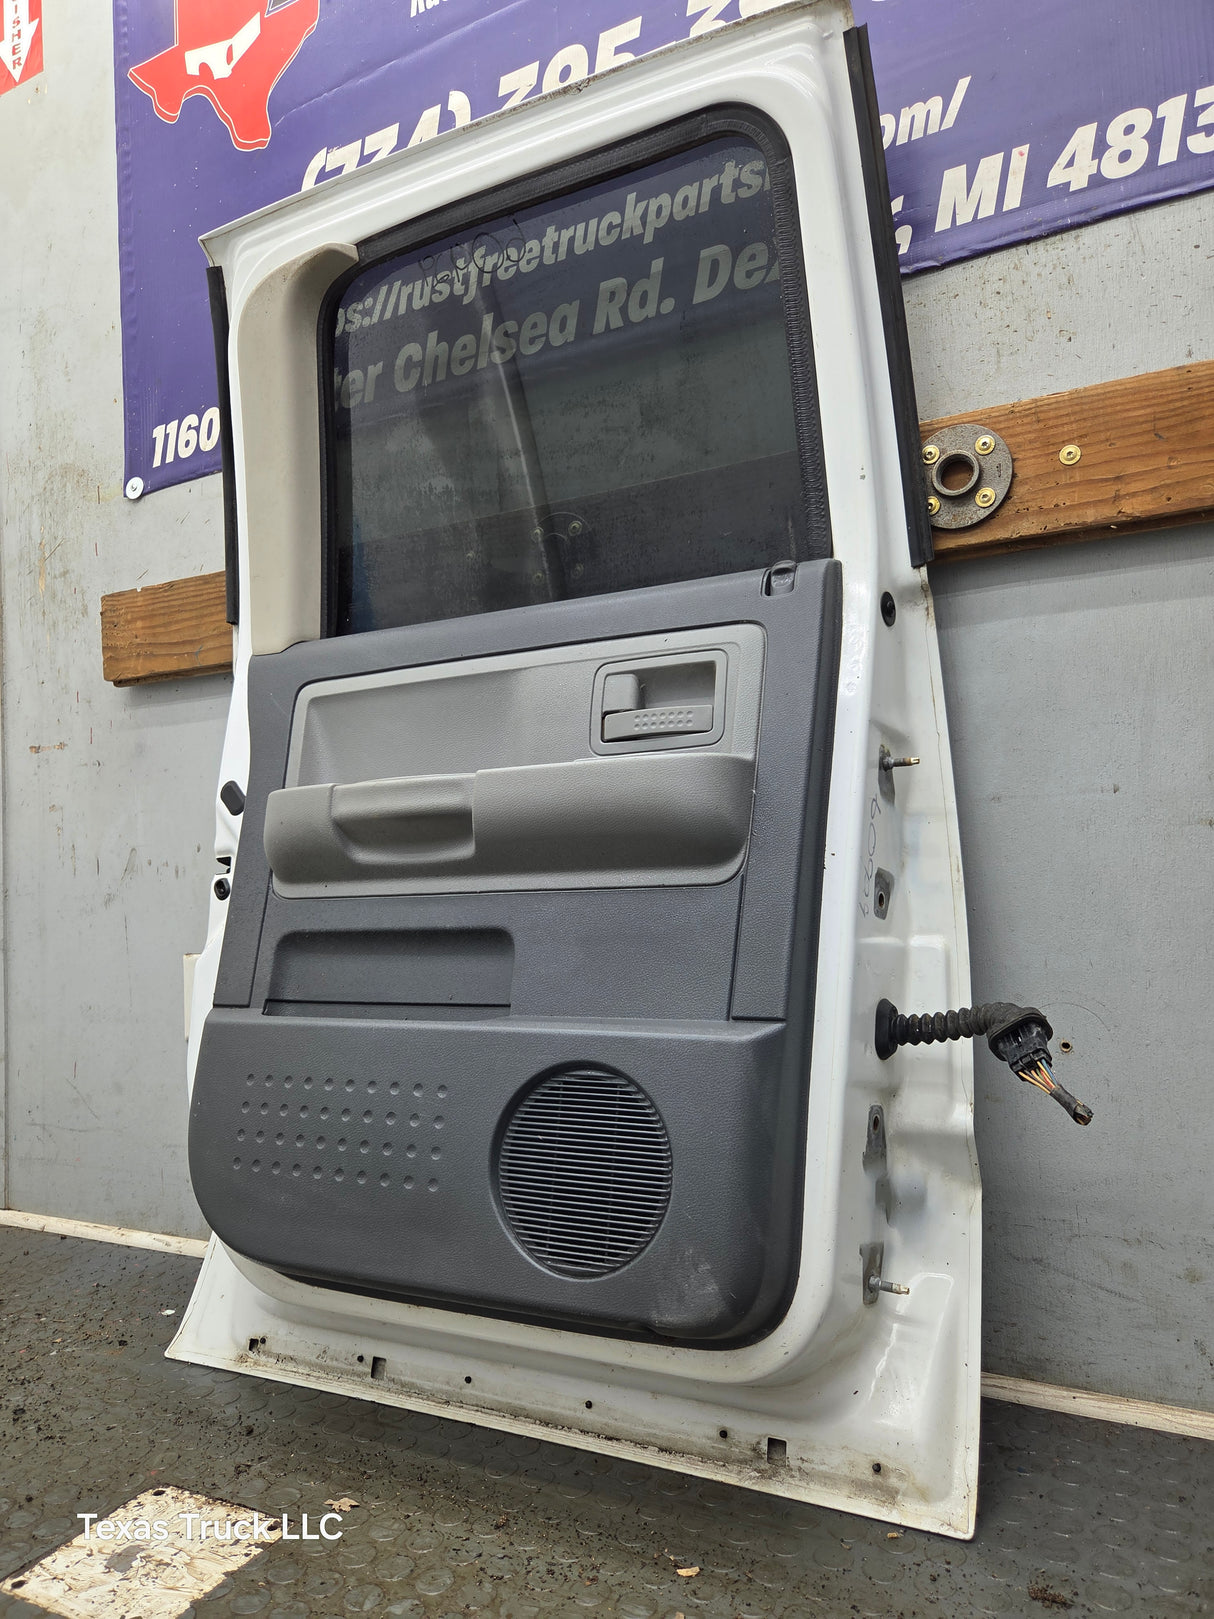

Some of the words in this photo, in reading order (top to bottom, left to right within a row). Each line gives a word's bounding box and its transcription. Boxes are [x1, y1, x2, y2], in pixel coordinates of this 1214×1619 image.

[11, 0, 22, 70] ISHER
[152, 406, 220, 468] 1160
[334, 361, 384, 411] er
[394, 299, 580, 392] Chelsea
[593, 256, 675, 335] Rd.
[935, 143, 1030, 233] MI
